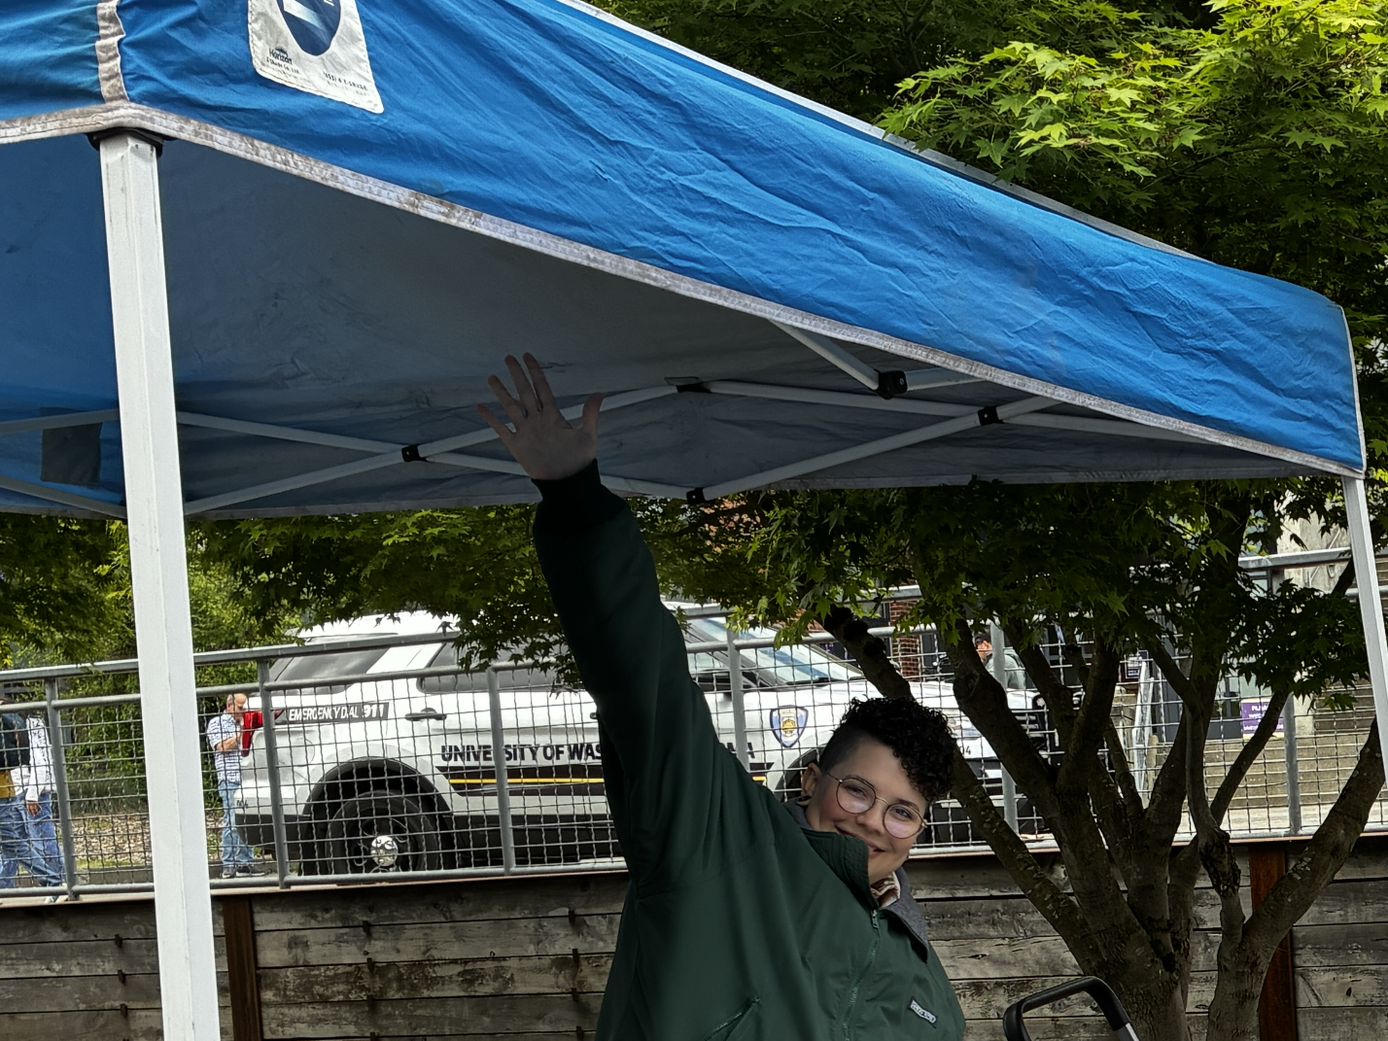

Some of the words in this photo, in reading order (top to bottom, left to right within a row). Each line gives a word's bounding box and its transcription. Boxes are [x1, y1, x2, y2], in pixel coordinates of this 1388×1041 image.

[362, 703, 385, 718] 911
[441, 744, 541, 762] UNIVESITY
[543, 744, 566, 760] OF
